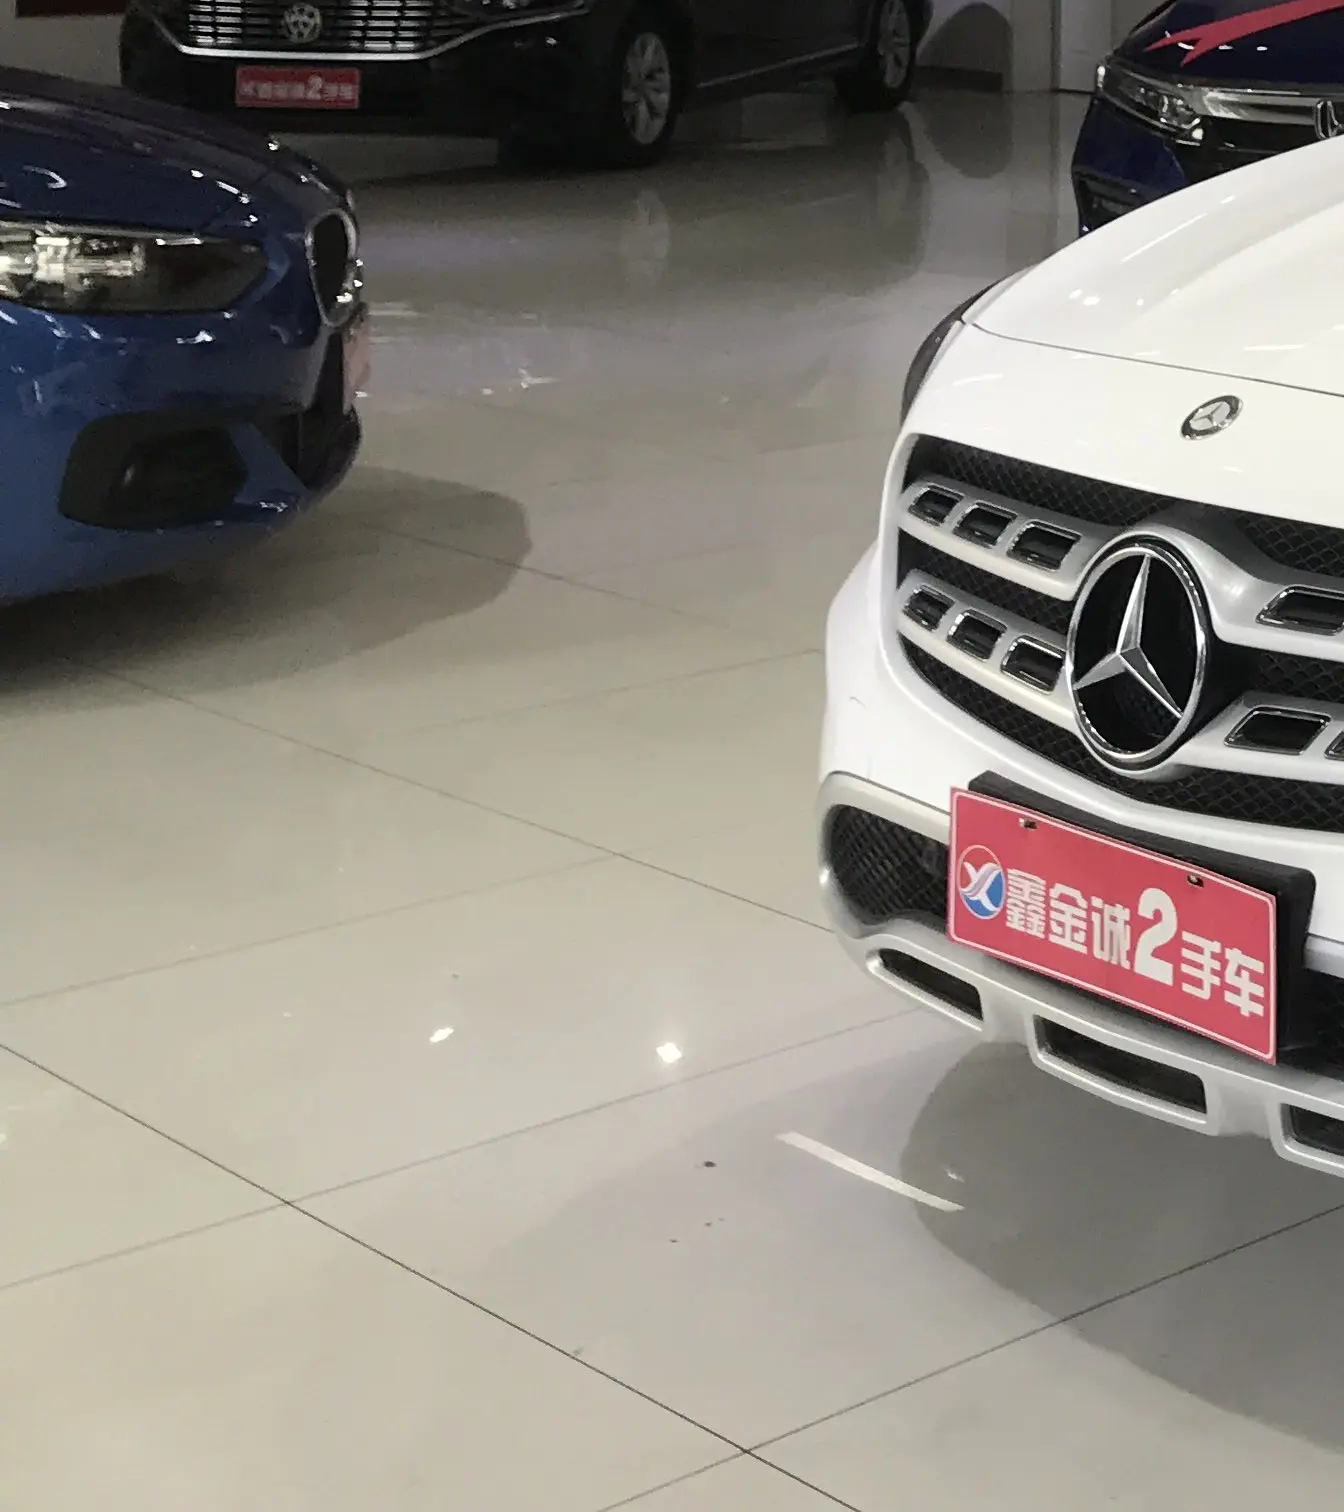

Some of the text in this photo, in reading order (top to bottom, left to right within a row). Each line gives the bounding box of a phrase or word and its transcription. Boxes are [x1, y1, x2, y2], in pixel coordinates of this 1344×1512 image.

[1005, 868, 1265, 1018] 鑫金诚2手车
